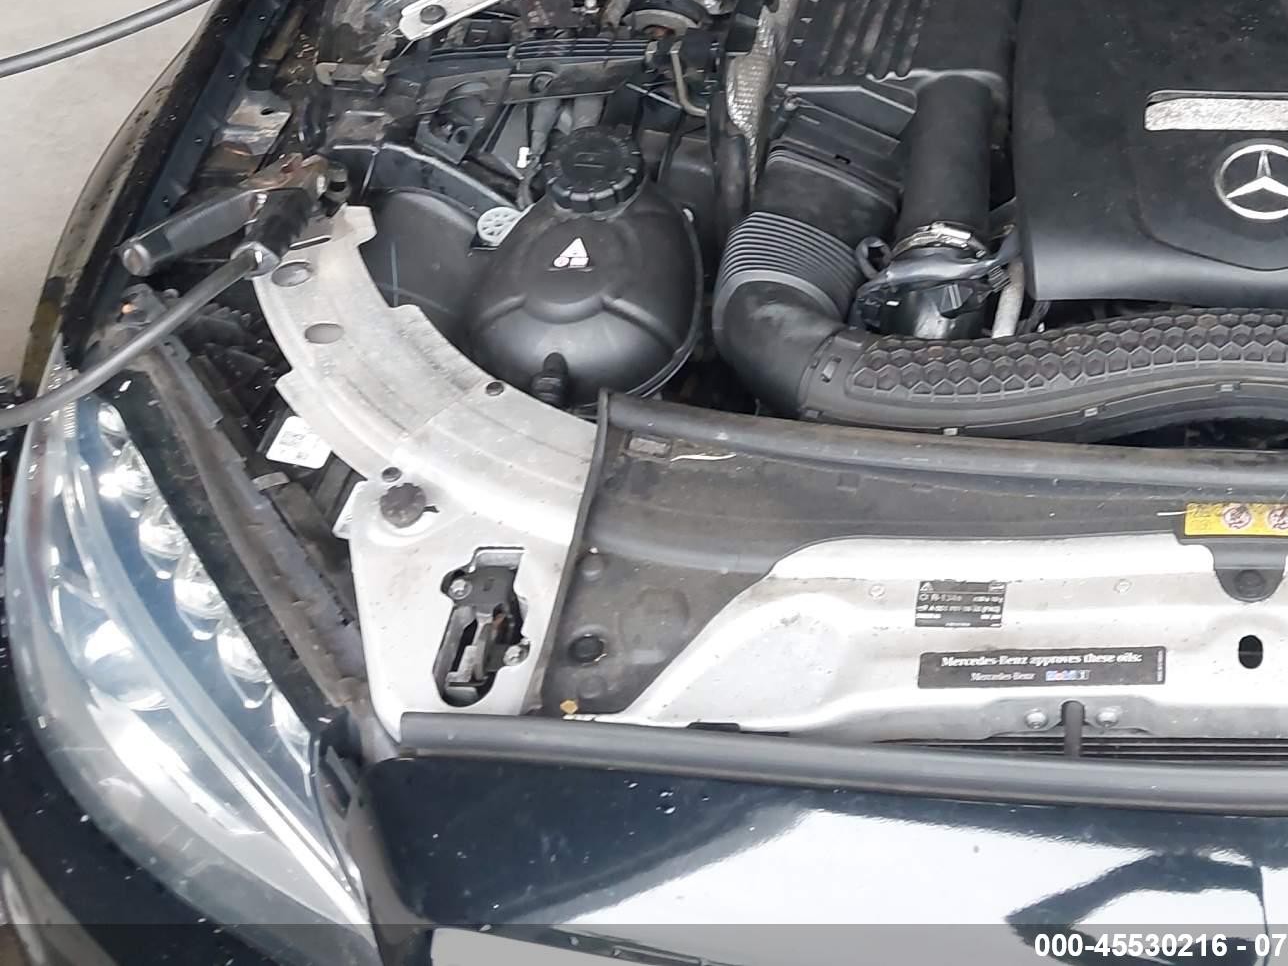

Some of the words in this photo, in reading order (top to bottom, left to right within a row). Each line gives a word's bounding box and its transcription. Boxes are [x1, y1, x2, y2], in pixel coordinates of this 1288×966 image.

[941, 655, 1027, 667] Mercedes-Benz
[1029, 654, 1081, 667] approves
[1083, 652, 1114, 664] these
